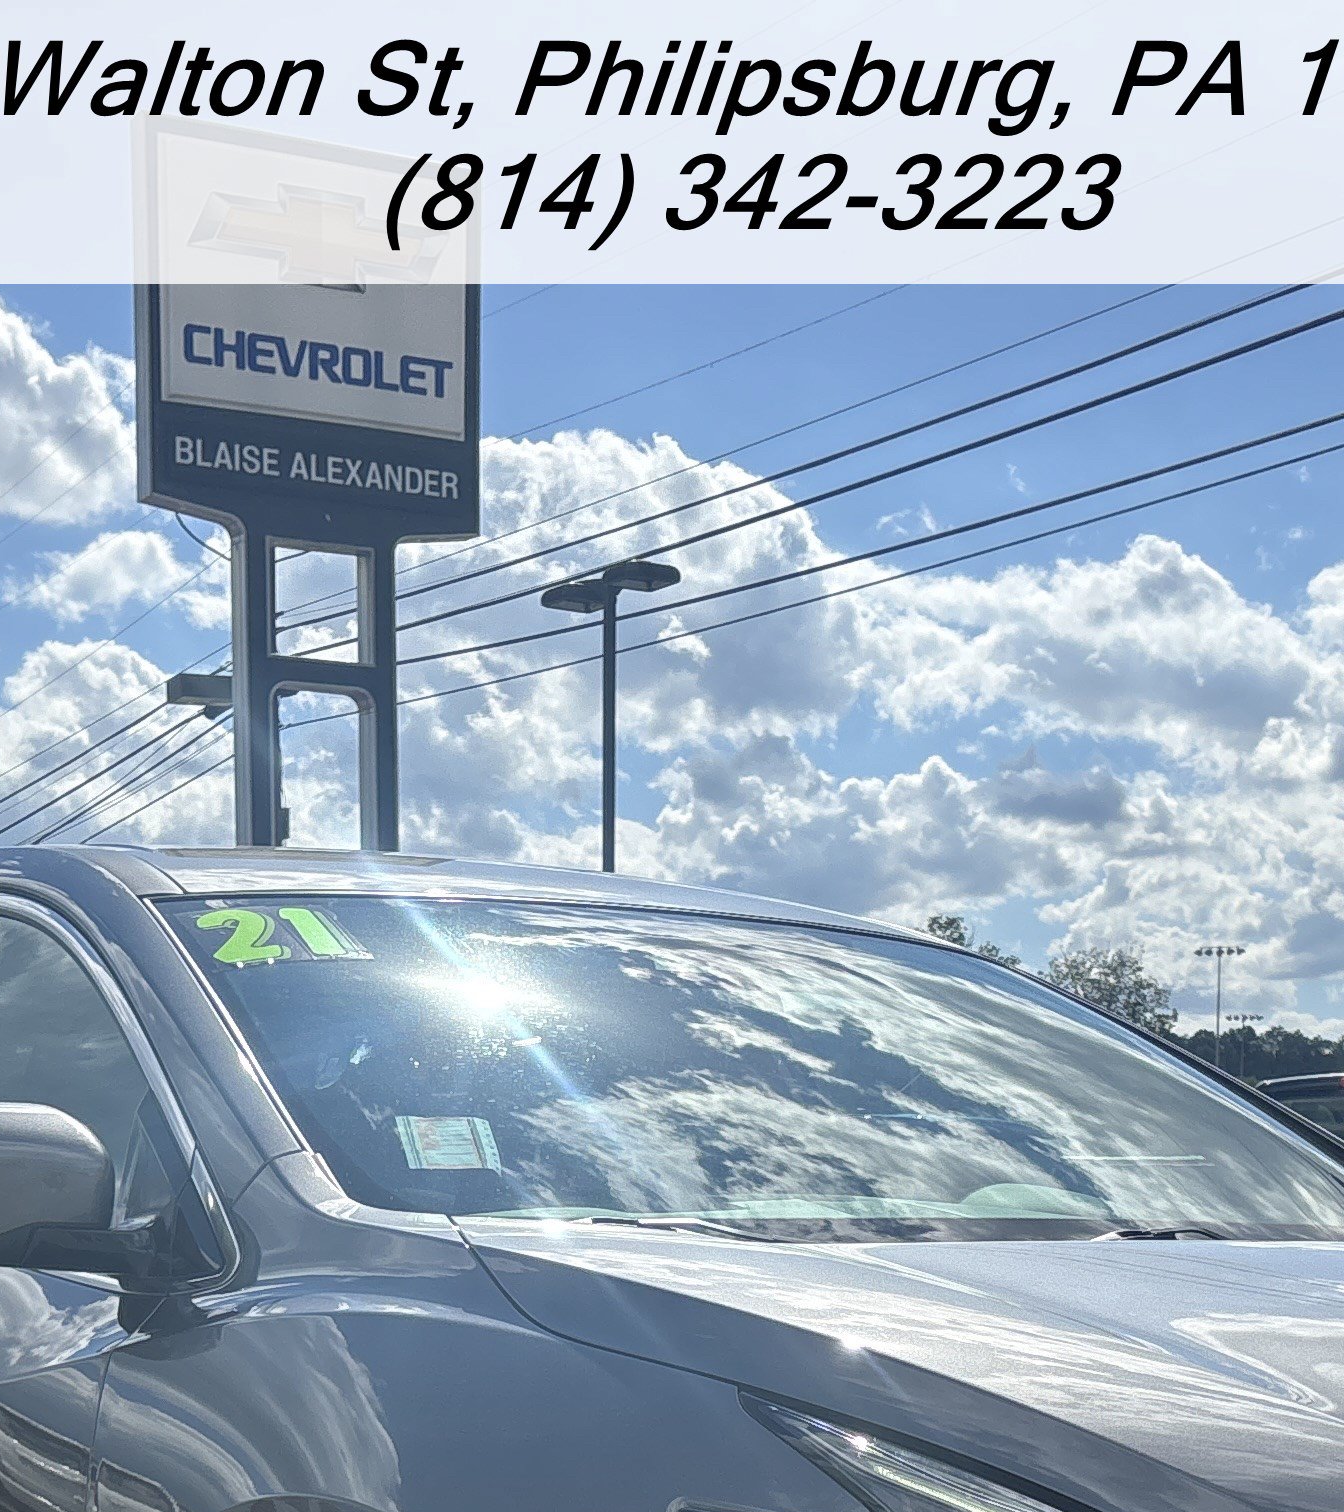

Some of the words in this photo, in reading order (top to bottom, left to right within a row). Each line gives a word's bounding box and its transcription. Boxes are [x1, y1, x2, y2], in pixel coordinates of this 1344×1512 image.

[183, 322, 454, 399] CHEVROLET
[174, 435, 281, 478] BLAISE
[289, 451, 460, 500] ALEXANDER
[196, 906, 352, 965] 21
